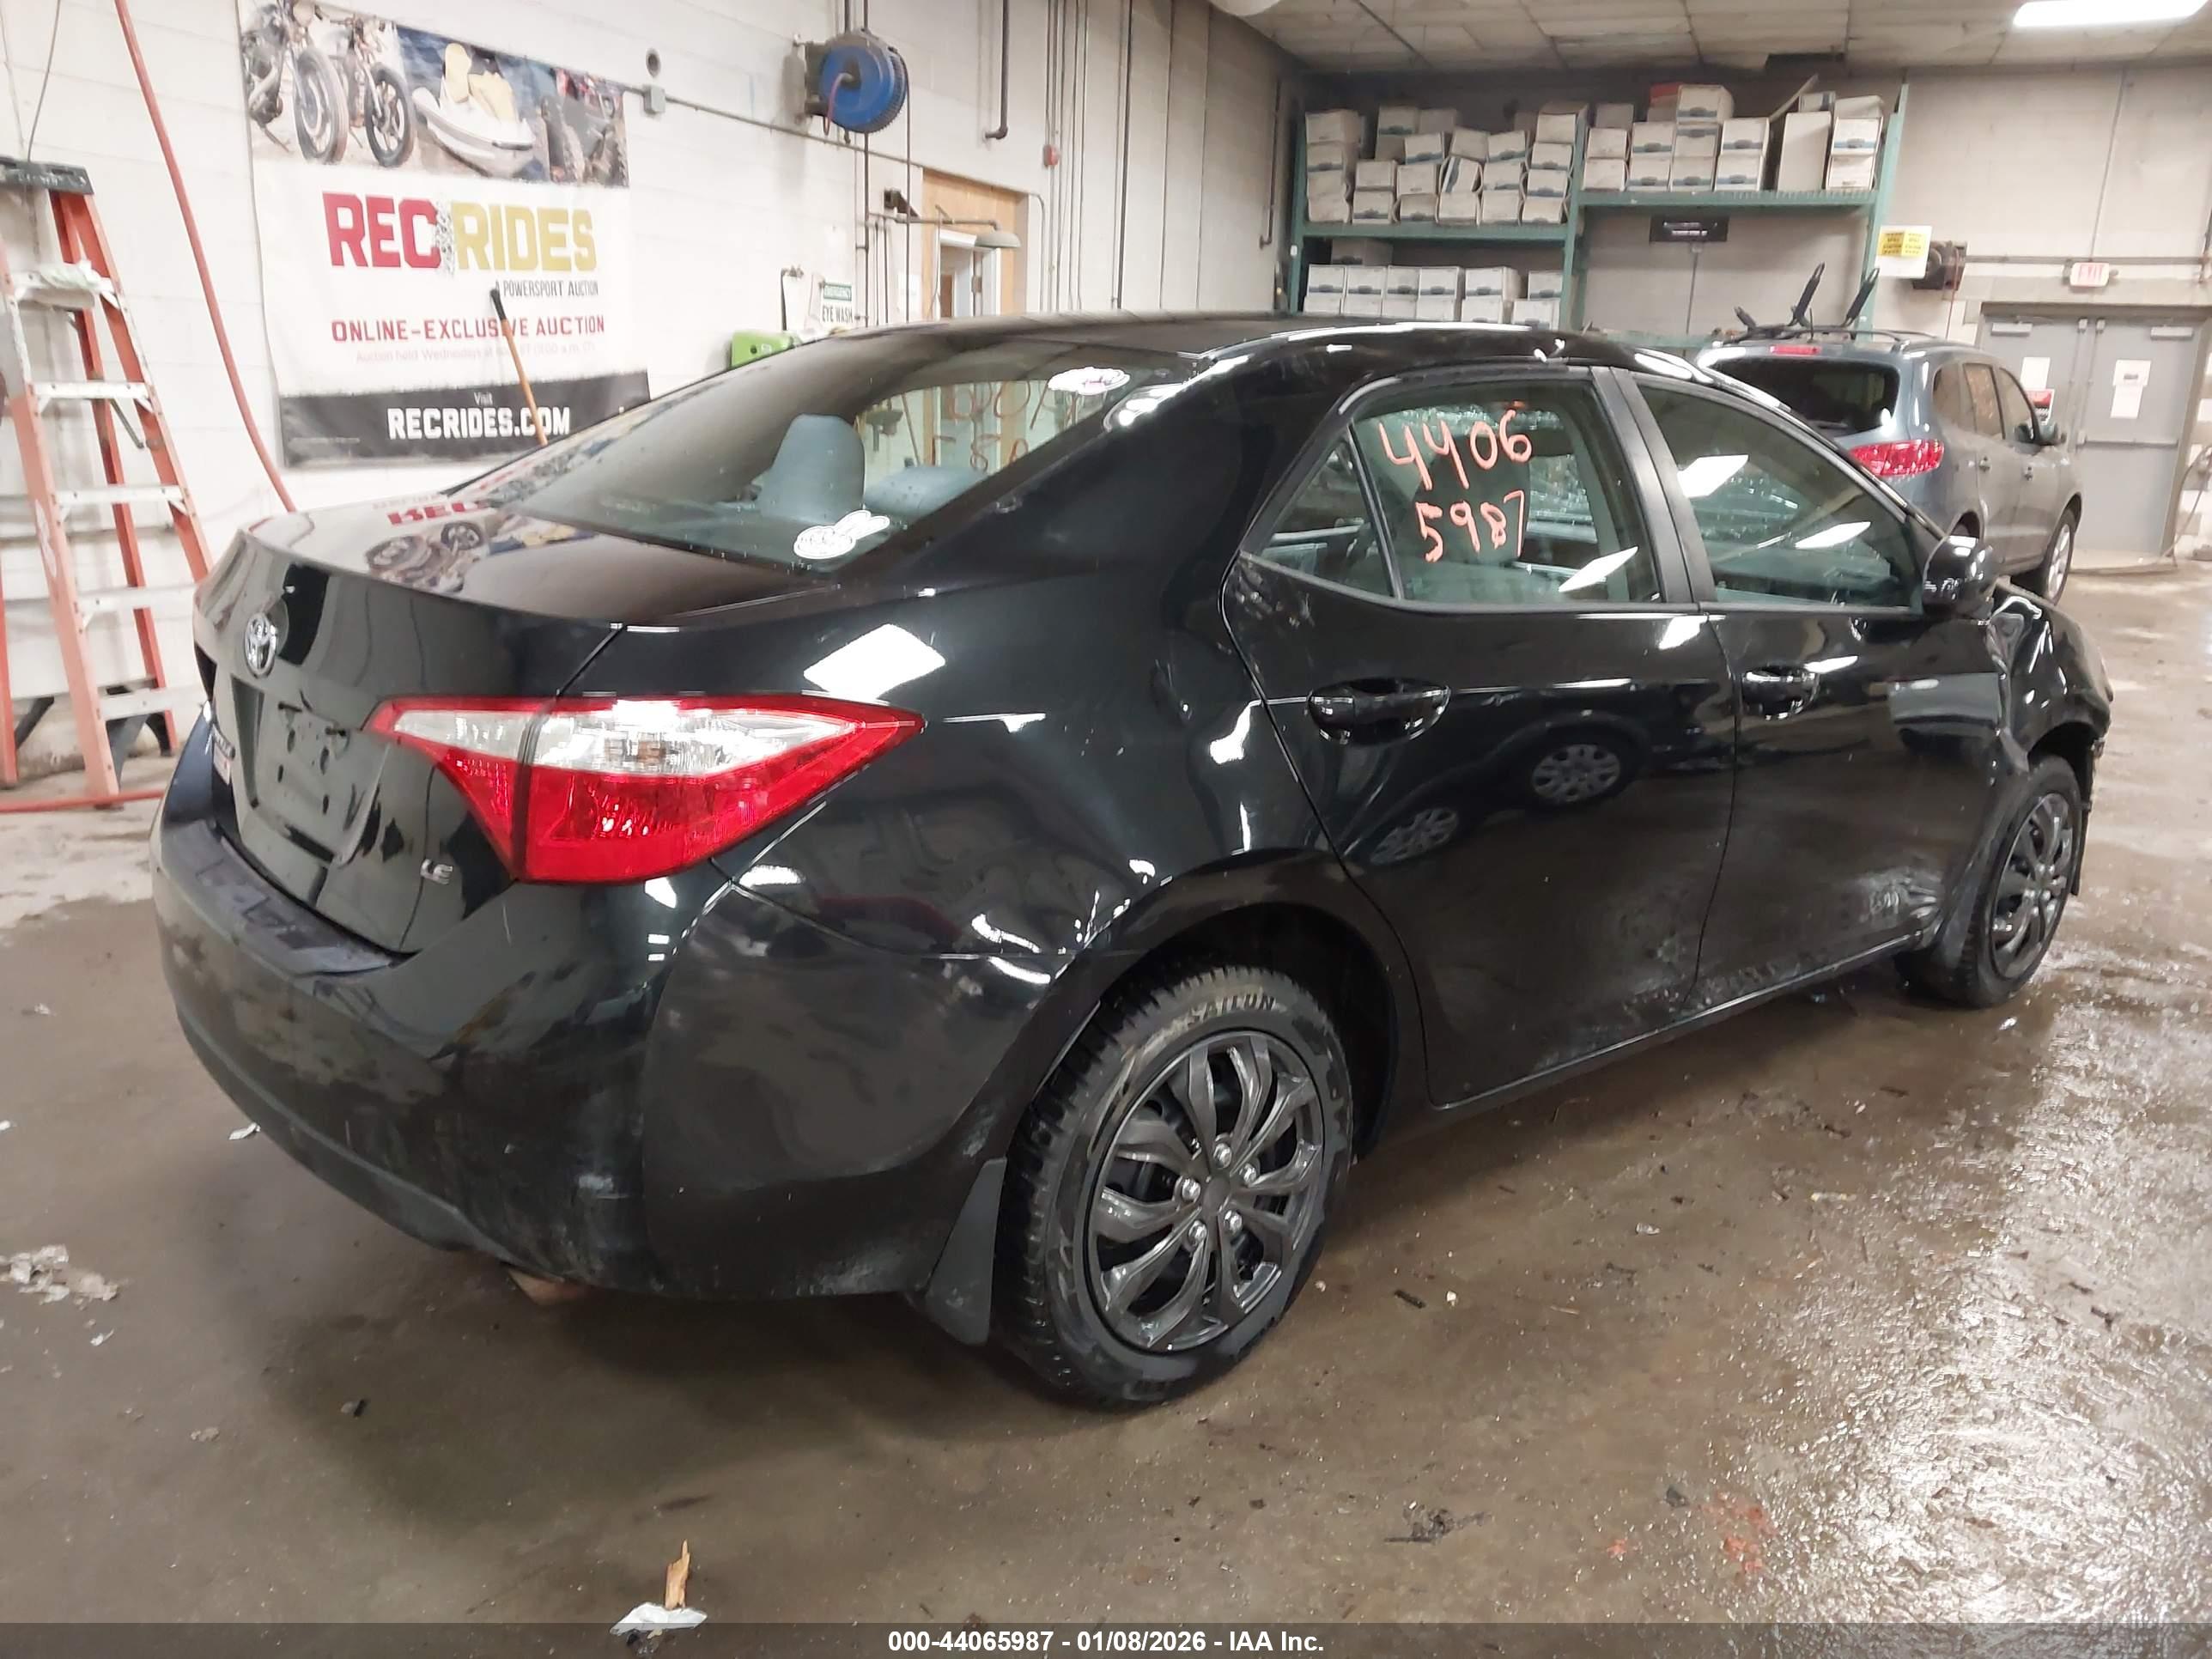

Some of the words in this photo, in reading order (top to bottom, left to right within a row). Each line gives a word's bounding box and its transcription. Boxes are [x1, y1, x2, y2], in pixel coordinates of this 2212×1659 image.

[322, 191, 442, 269] REC
[452, 200, 597, 271] RIDES
[502, 279, 563, 296] POWERSPORT
[568, 279, 599, 296] AUCTION
[331, 316, 529, 343] ONLINE-EXCLUSVE
[536, 314, 605, 336] AUCTION
[822, 304, 834, 323] EYE
[836, 305, 854, 324] WASH
[473, 390, 494, 405] Visit
[386, 406, 570, 440] RECRIDES.COM
[1378, 410, 1533, 490] 4406
[1415, 489, 1525, 562] 5987
[420, 859, 453, 885] LE
